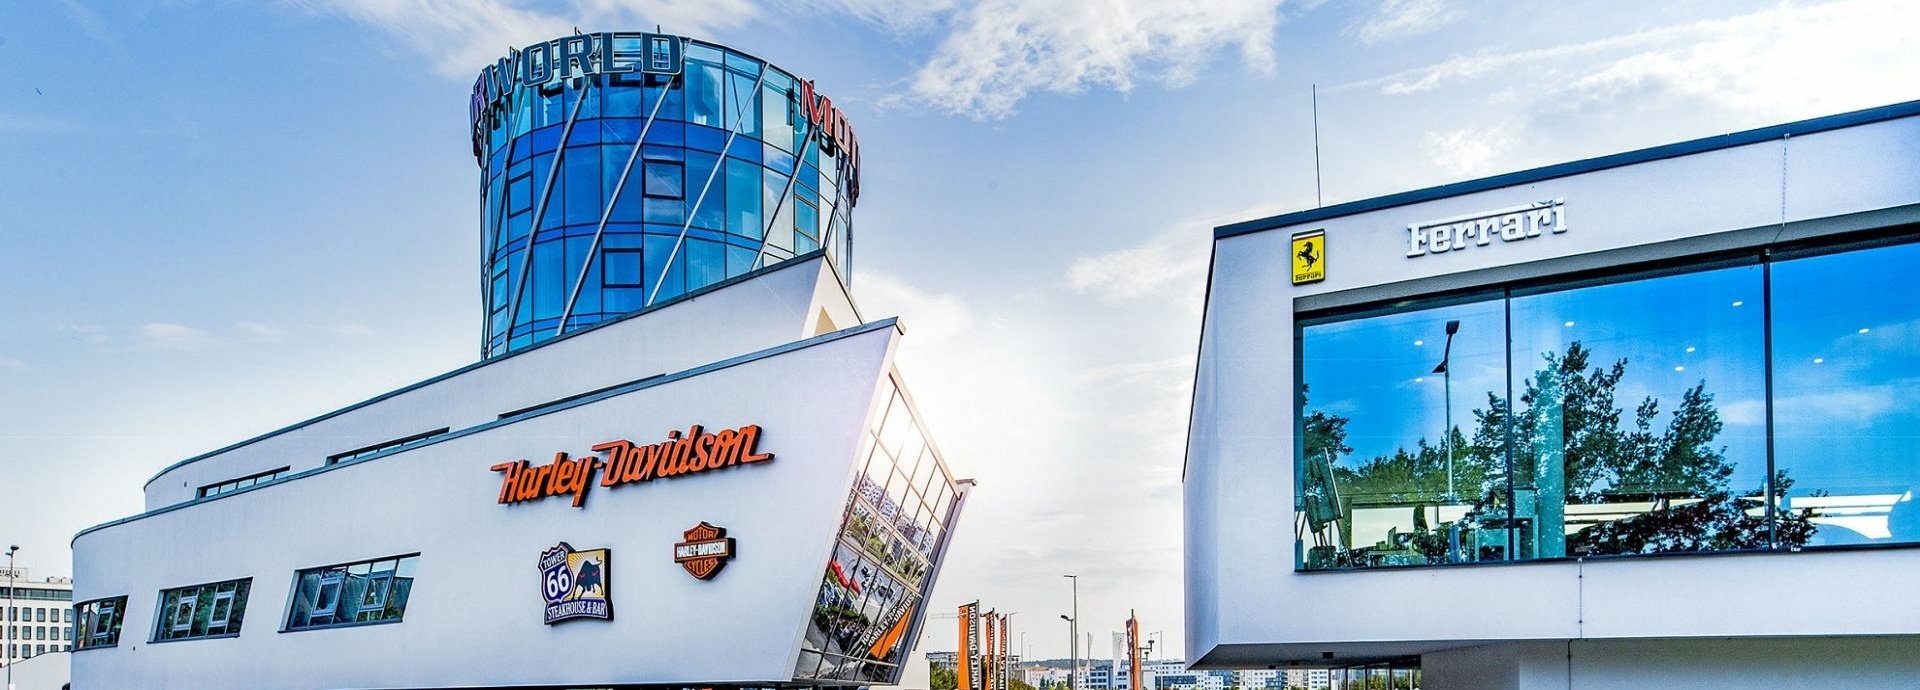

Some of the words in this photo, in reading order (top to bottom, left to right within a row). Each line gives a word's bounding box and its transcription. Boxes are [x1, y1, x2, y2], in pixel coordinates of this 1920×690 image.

[1406, 197, 1567, 257] Ferrari
[1295, 271, 1322, 281] Ferrari
[491, 424, 775, 507] Harley-Davidson
[687, 527, 714, 540] MOTOR
[677, 542, 726, 558] HARLEY-DAVIDSON
[542, 550, 566, 570] TOWER
[687, 559, 714, 575] CYCLES
[547, 565, 570, 598] 66
[547, 602, 586, 620] STEAKHOUSE
[586, 601, 593, 614] &
[592, 602, 606, 616] BAR
